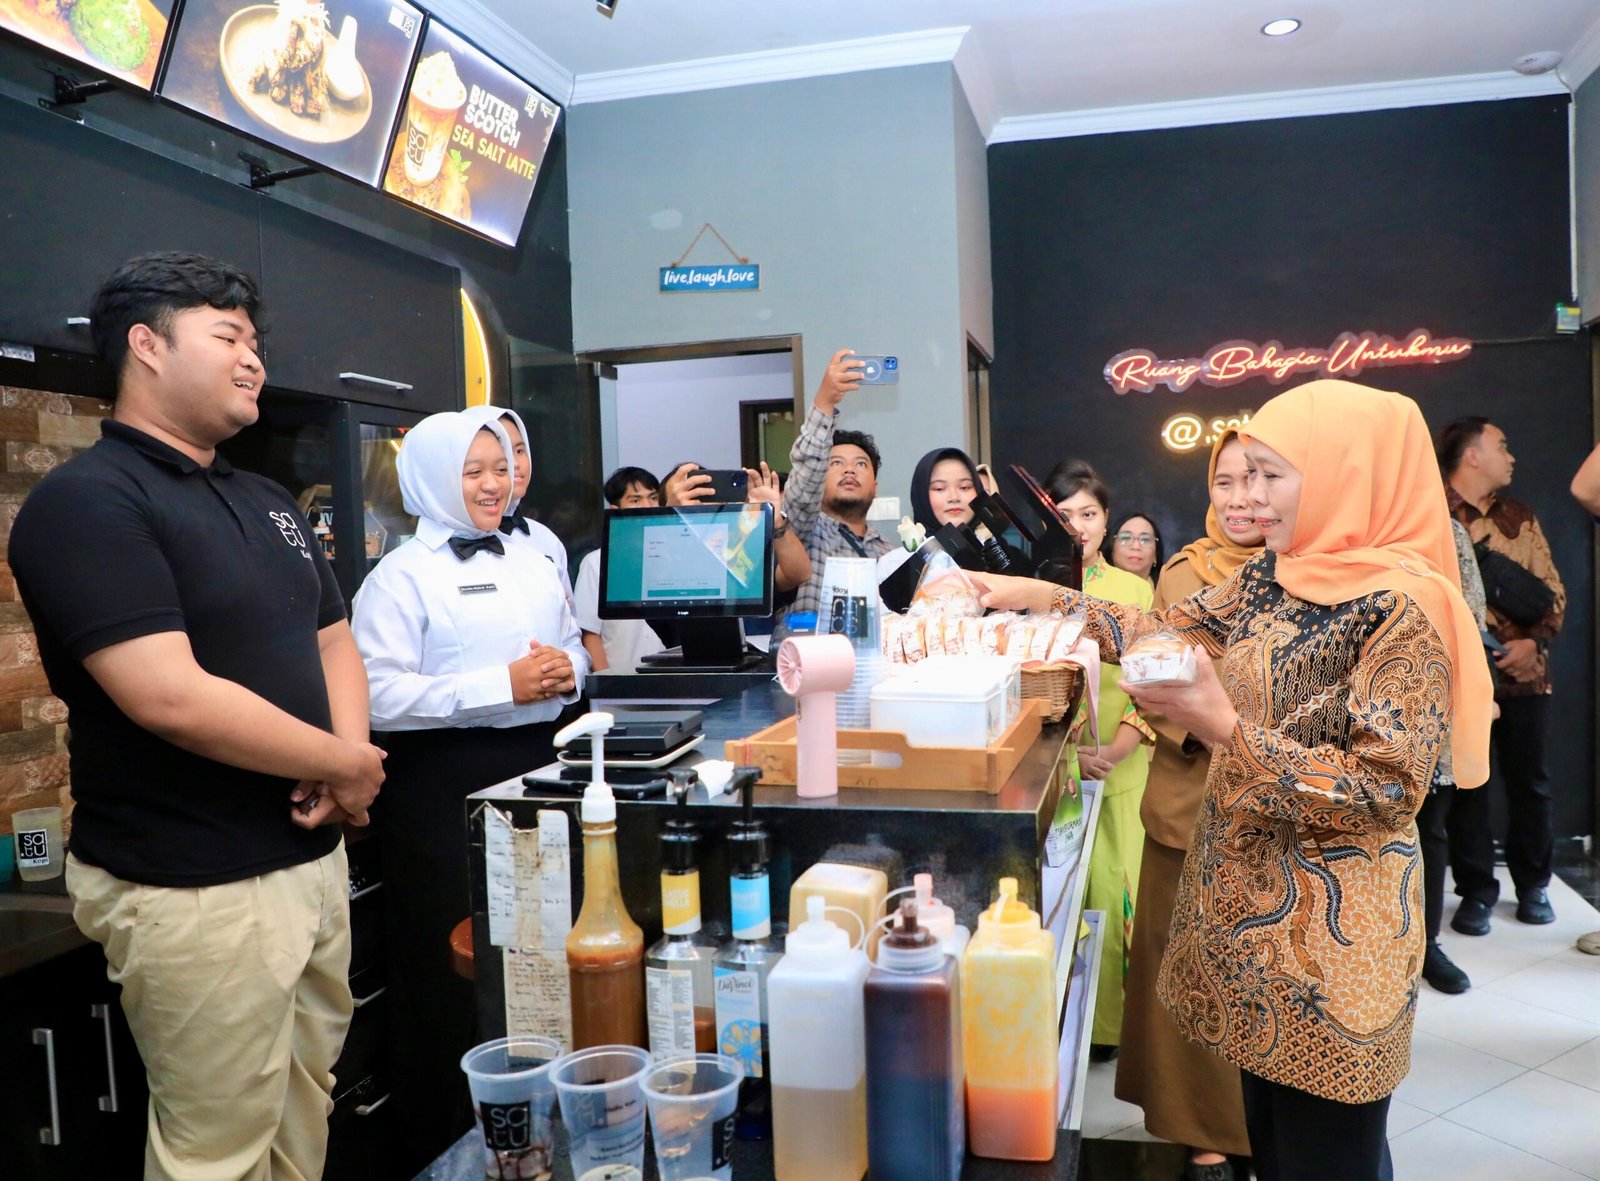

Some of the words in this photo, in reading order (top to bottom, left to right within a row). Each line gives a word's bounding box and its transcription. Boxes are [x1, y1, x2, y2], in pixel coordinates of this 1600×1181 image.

[464, 103, 521, 149] SCOTCH
[469, 84, 519, 128] BUTTER
[452, 124, 475, 150] SEA
[477, 138, 506, 164] SALT
[505, 152, 536, 180] LATTE
[1111, 354, 1202, 389] Ruang
[1205, 346, 1322, 381] Bahagia
[1327, 334, 1472, 373] Untukmu
